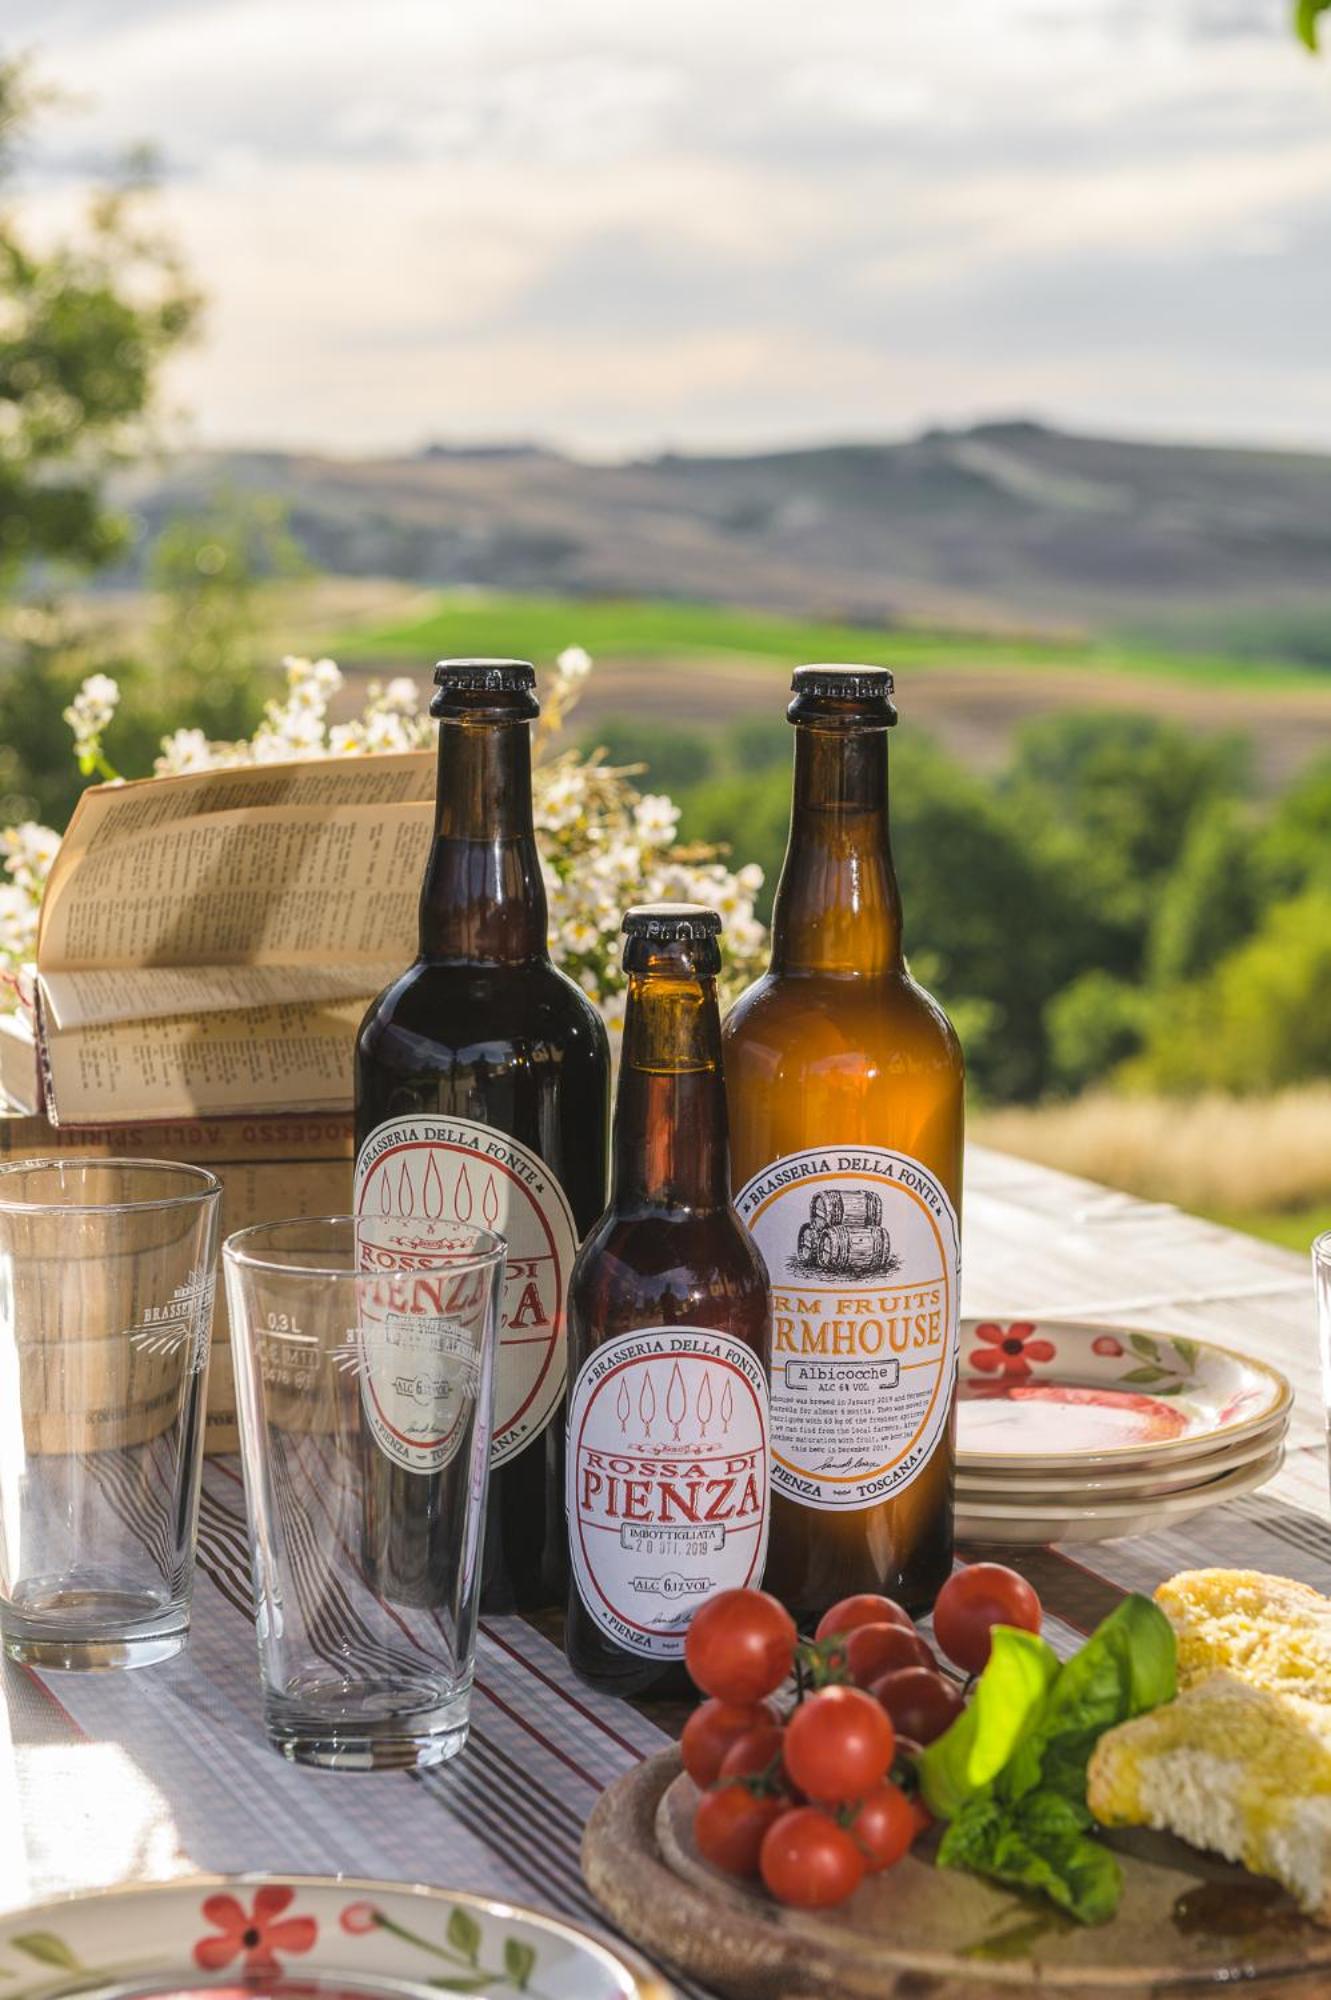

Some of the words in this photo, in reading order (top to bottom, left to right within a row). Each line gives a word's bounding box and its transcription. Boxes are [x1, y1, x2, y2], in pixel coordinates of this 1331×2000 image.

[362, 1128, 419, 1169] BRASSERIA
[424, 1127, 480, 1149] DELLA
[485, 1142, 537, 1185] FONTE
[751, 1159, 831, 1206] BRASSERIA
[837, 1157, 894, 1178] DELLA
[898, 1169, 939, 1208] FONTE
[835, 1290, 940, 1315] FRUITS
[774, 1310, 942, 1355] RMHOUSE
[592, 1340, 664, 1380] BRASSERIA
[670, 1339, 720, 1357] DELLA
[726, 1347, 758, 1384] FONTE
[798, 1367, 888, 1380] Albicocche
[818, 1383, 835, 1392] ALC
[853, 1383, 869, 1391] VOL
[587, 1452, 710, 1479] ROSSA
[724, 1454, 757, 1476] DI
[770, 1463, 822, 1498] PIENZA
[856, 1454, 918, 1497] TOSCANA
[581, 1468, 761, 1523] PIENZA
[630, 1528, 716, 1540] IMBOTTIGLIATA
[608, 1614, 653, 1648] PIENZA
